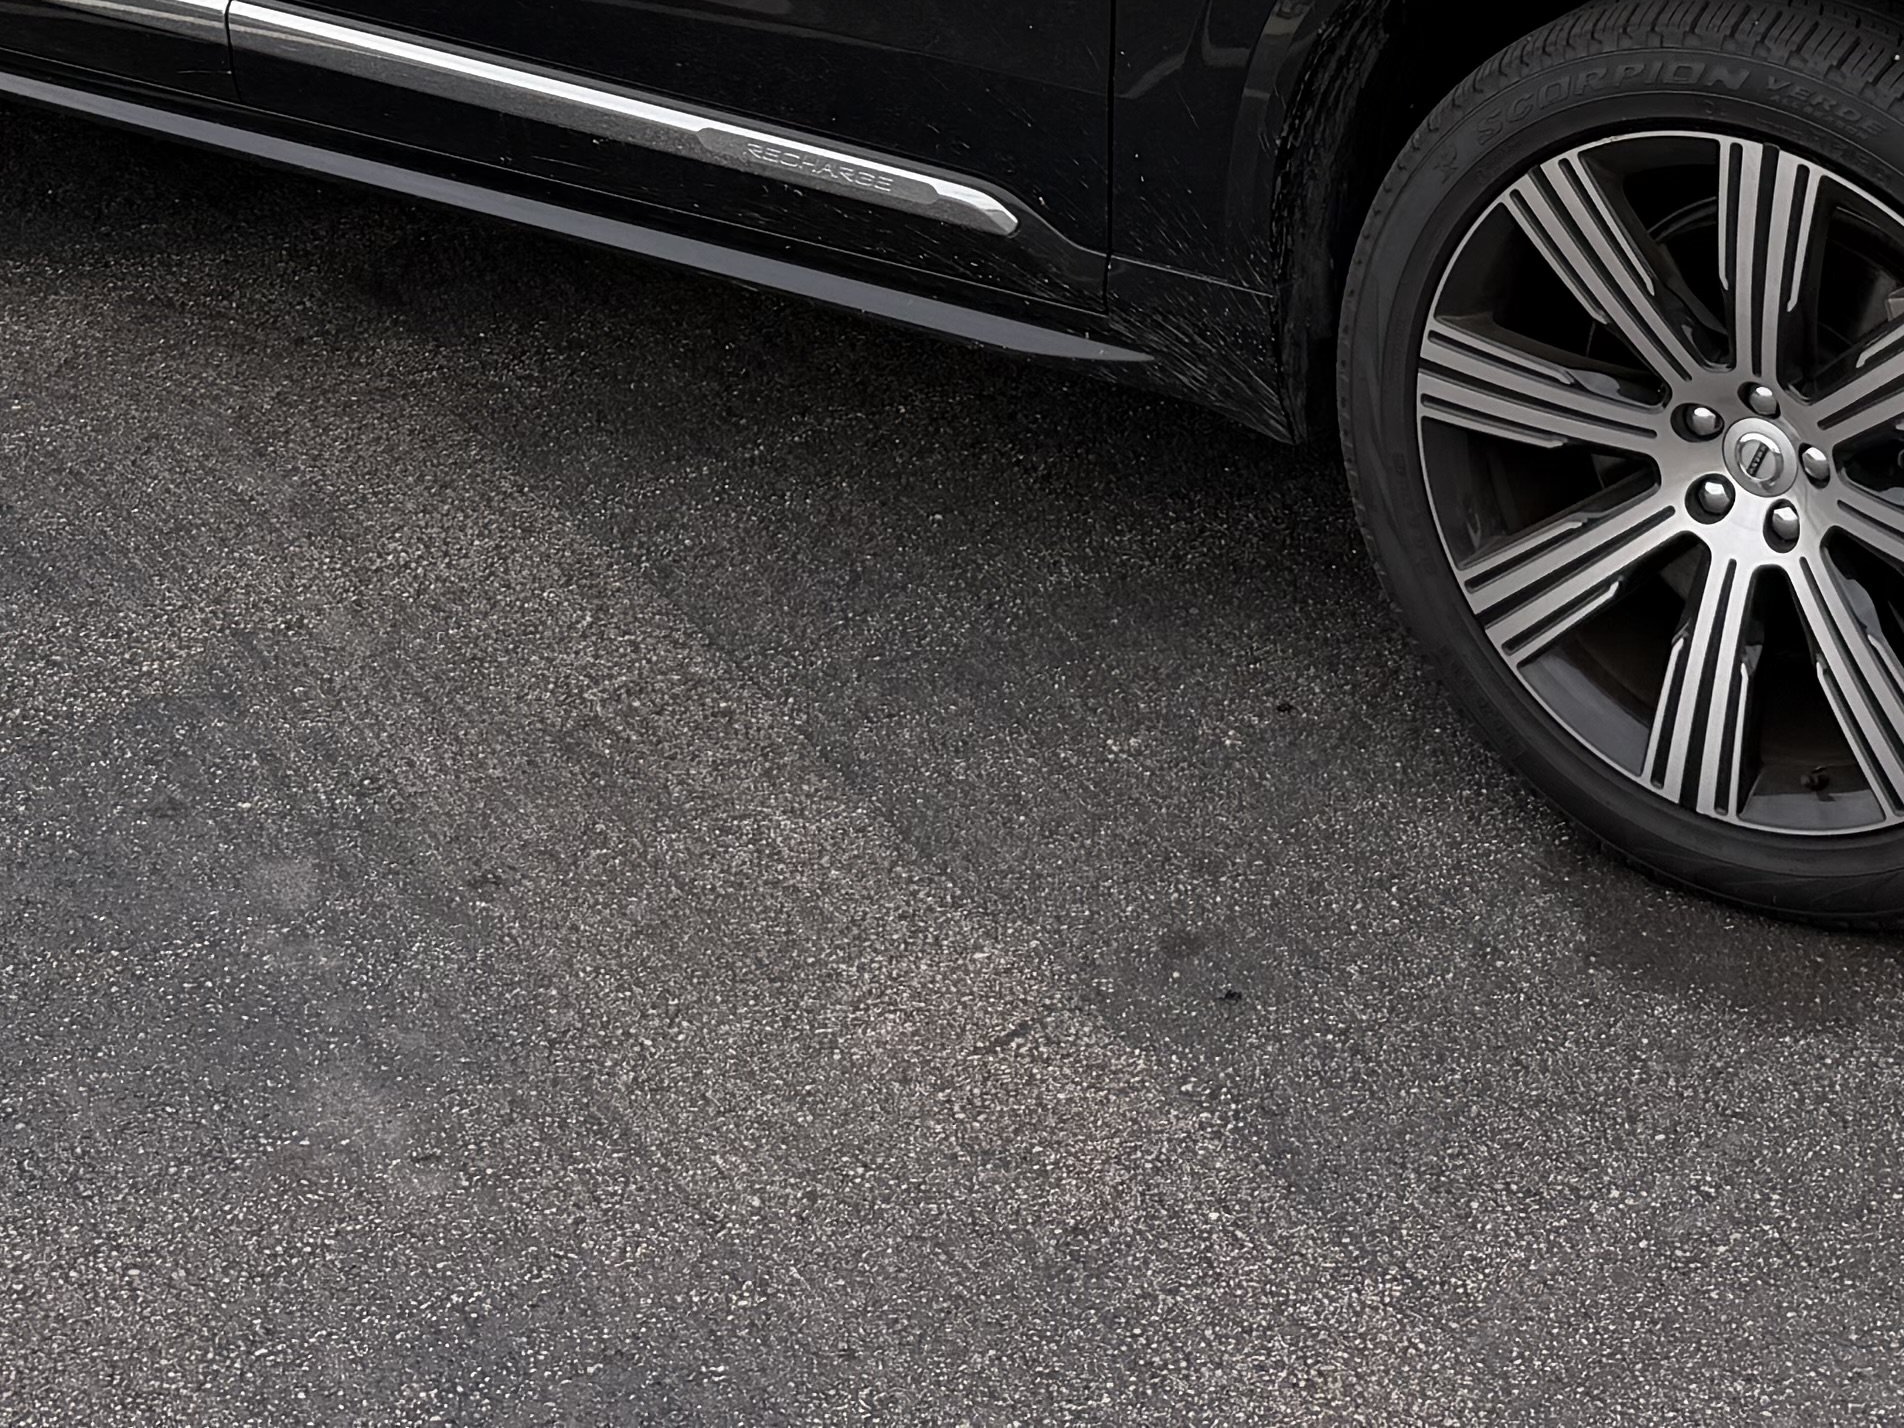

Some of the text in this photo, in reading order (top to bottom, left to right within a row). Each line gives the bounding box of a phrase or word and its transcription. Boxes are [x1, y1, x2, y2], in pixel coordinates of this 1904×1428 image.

[1477, 60, 1751, 146] SCORPION
[1766, 74, 1887, 136] VERDE
[745, 142, 895, 193] RECHARGE
